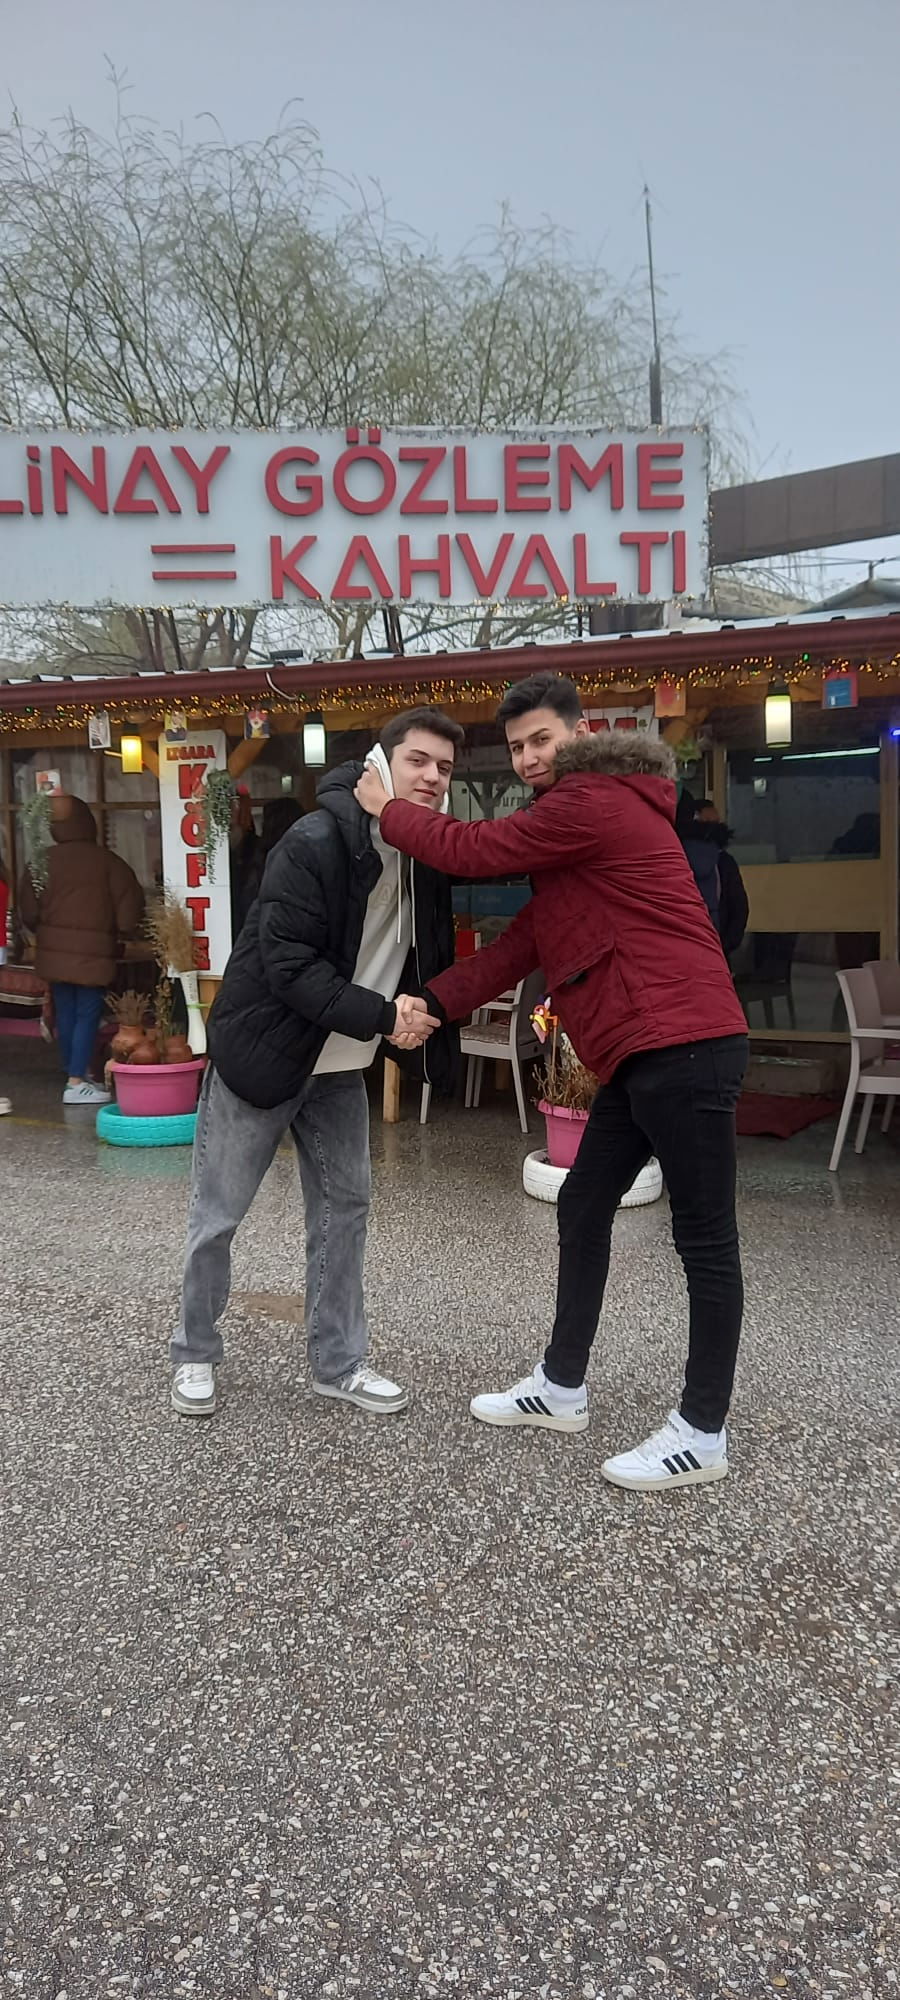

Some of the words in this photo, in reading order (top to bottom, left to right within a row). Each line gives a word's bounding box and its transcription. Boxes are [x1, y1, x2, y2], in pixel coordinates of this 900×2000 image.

[264, 427, 684, 516] GÖZLEME
[269, 530, 686, 599] KAHVALTI
[178, 763, 211, 971] KÖFTE
